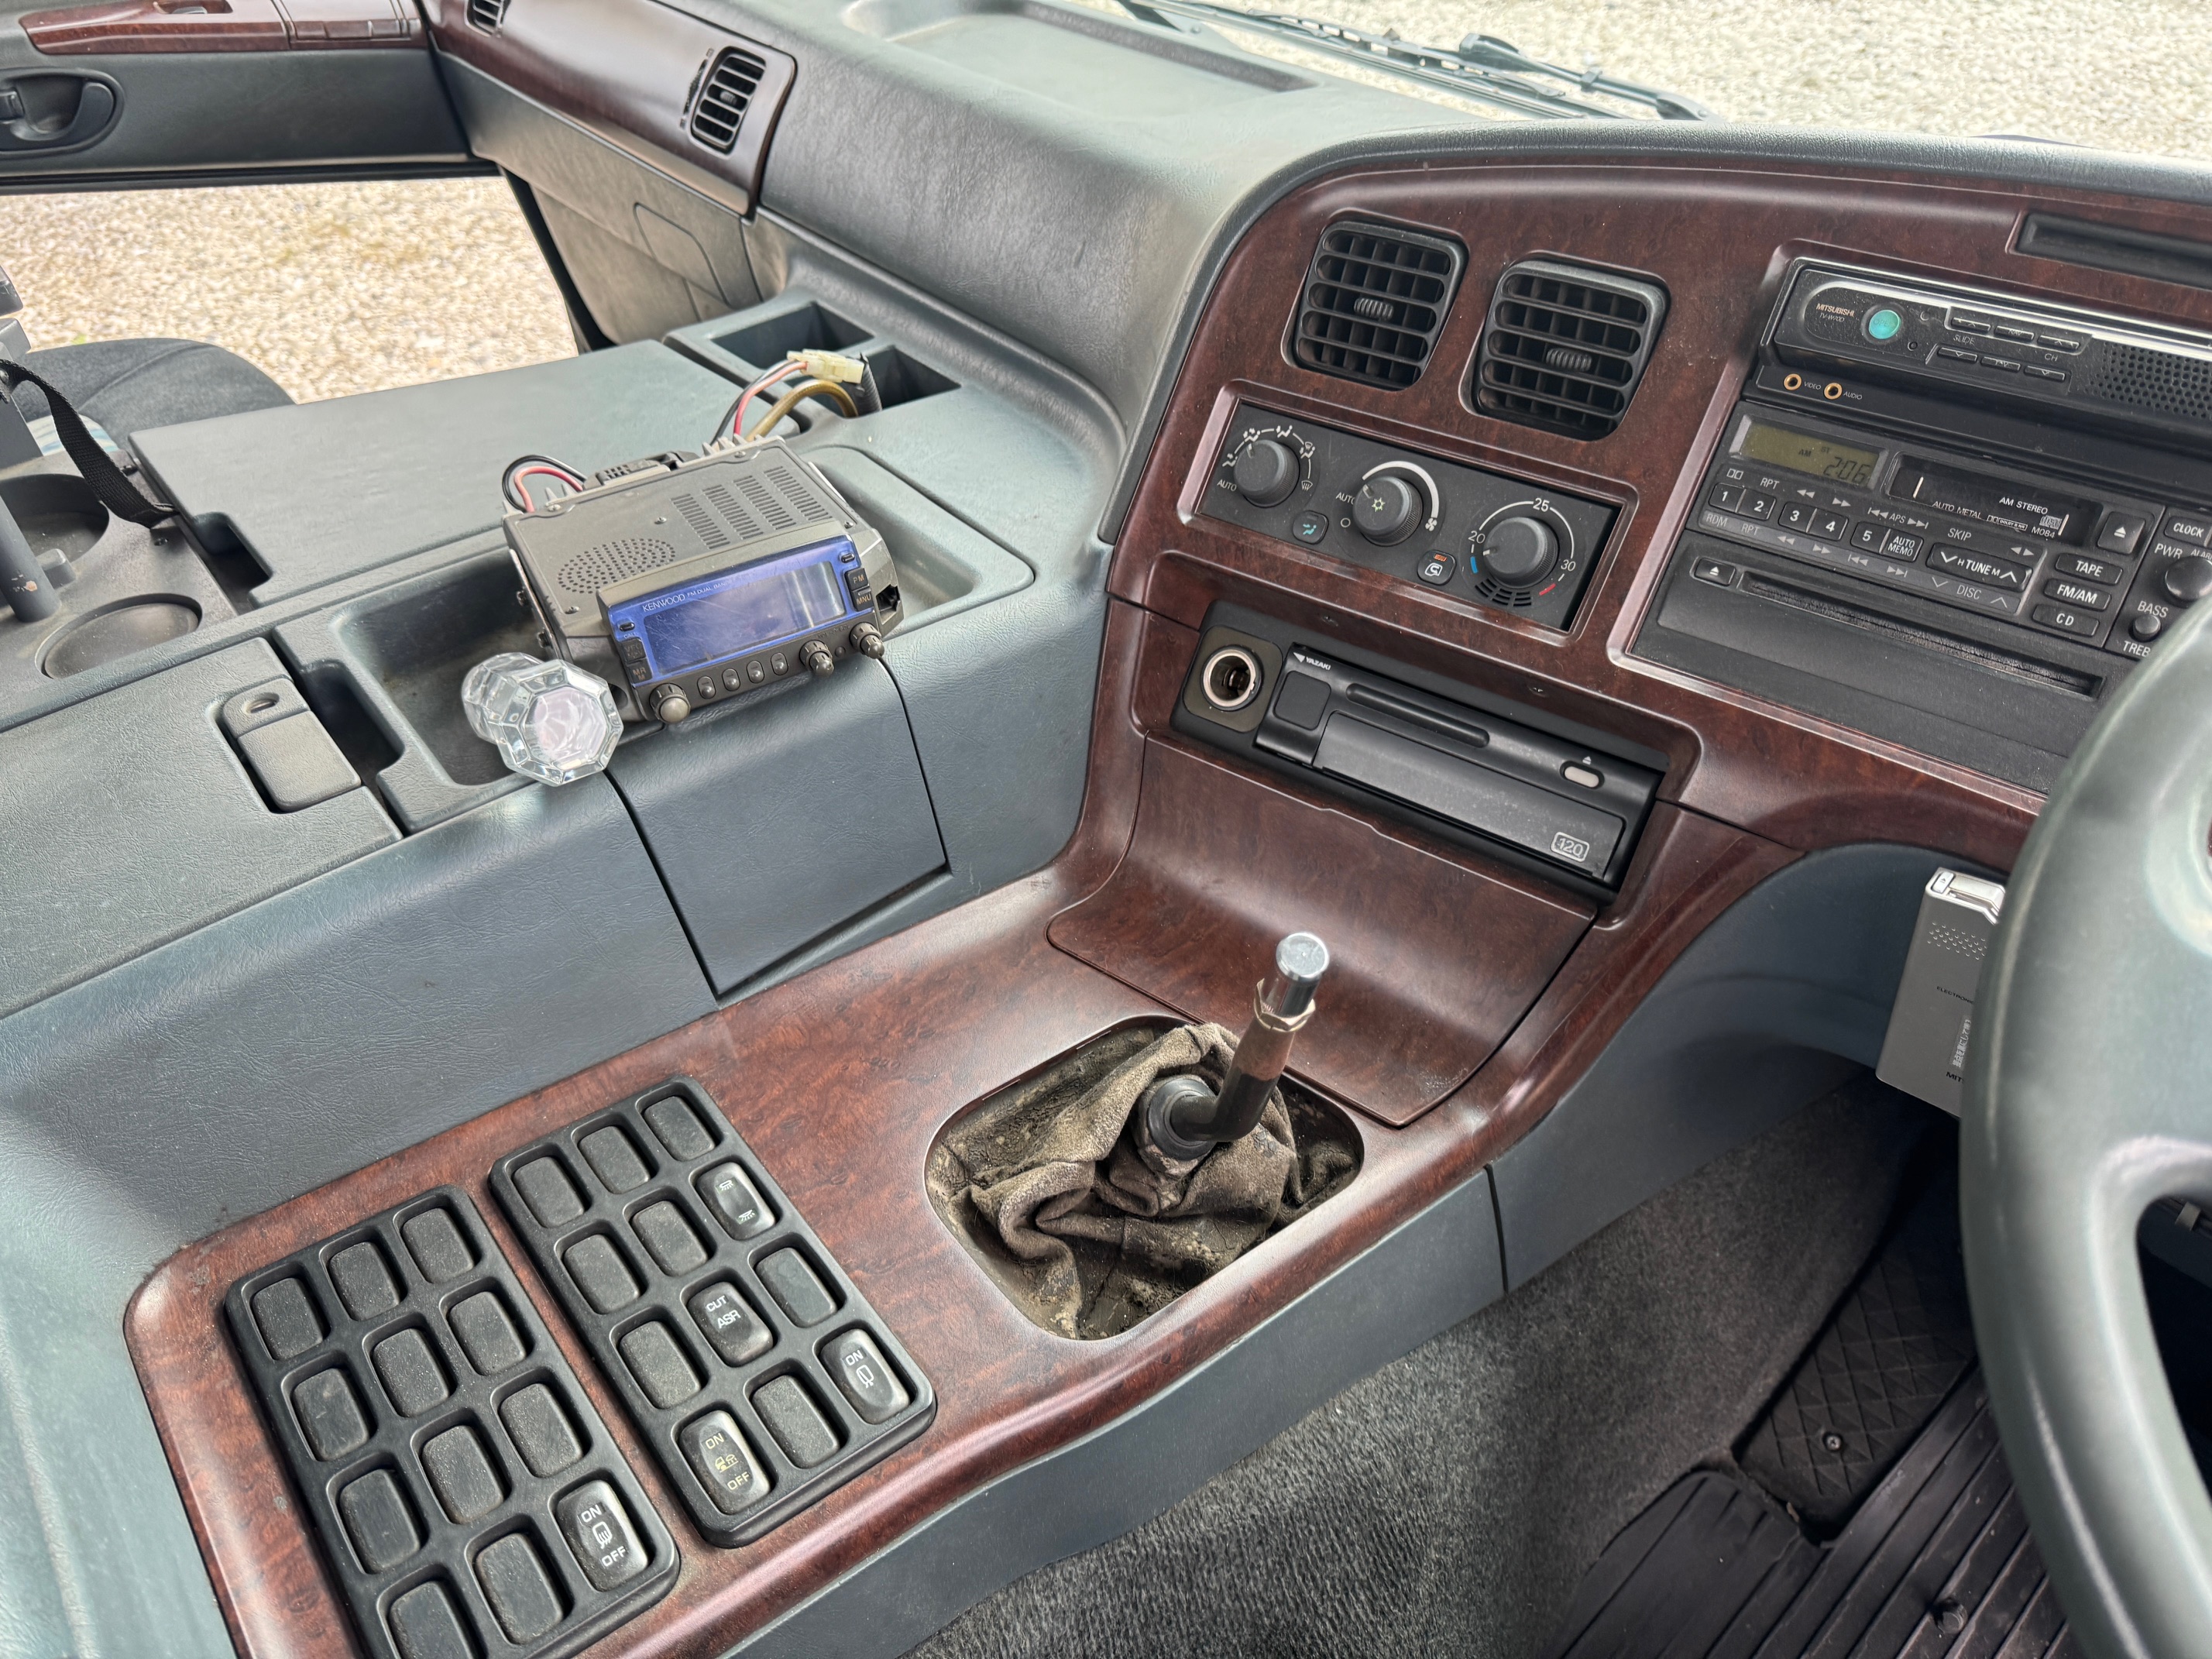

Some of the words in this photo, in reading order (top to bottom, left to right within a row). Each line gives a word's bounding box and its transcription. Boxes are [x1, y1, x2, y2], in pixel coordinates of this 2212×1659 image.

[1816, 303, 1855, 317] MITSUBISHI
[1953, 334, 1975, 346] SLIDE
[2044, 352, 2059, 362] CH
[1803, 380, 1822, 390] VIDEO
[1843, 390, 1863, 400] AUDIO
[1798, 448, 1812, 458] AM
[1821, 446, 1830, 455] ST
[1823, 456, 1870, 485] 2:06
[1217, 479, 1238, 492] AUTO
[1760, 477, 1780, 489] RPT
[1722, 491, 1729, 502] 1
[1533, 497, 1550, 512] 25
[1754, 500, 1764, 513] 2
[1932, 500, 1955, 513] AUTO
[1956, 507, 1983, 520] METAL
[1999, 496, 2014, 507] AM
[2015, 500, 2049, 515] STEREO
[1705, 513, 1728, 527] RDM
[1790, 510, 1800, 522] 3
[1889, 513, 1907, 524] APS
[1741, 524, 1760, 536] RPT
[1826, 520, 1836, 532] 4
[2031, 526, 2056, 539] M084
[2173, 522, 2204, 538] CLOCK
[1468, 530, 1486, 544] 20
[1862, 530, 1873, 541] 5
[1947, 527, 1972, 541] SKIP
[1892, 535, 1915, 549] AUTO
[1887, 543, 1914, 557] MEMO
[2154, 543, 2183, 559] PWR
[1560, 559, 1576, 572] 30
[1966, 559, 1992, 575] TUNE
[2076, 559, 2104, 577] TAPE
[853, 574, 864, 584] PM
[856, 593, 872, 605] MNU
[1956, 584, 1982, 600] DISC
[2057, 584, 2098, 605] FM/AM
[642, 593, 685, 613] KENWOOD
[697, 586, 713, 595] DUAL
[2137, 600, 2169, 618] BASS
[2056, 612, 2075, 627] CD
[1306, 656, 1331, 671] YAZAKI
[632, 667, 646, 676] MR
[1946, 1071, 1963, 1083] MIT
[706, 1295, 727, 1312] CUT
[716, 1310, 741, 1329] ASR
[845, 1349, 864, 1366] ON
[705, 1433, 725, 1450] ON
[726, 1471, 750, 1490] OFF
[581, 1504, 602, 1523] ON
[601, 1545, 626, 1567] OFF
